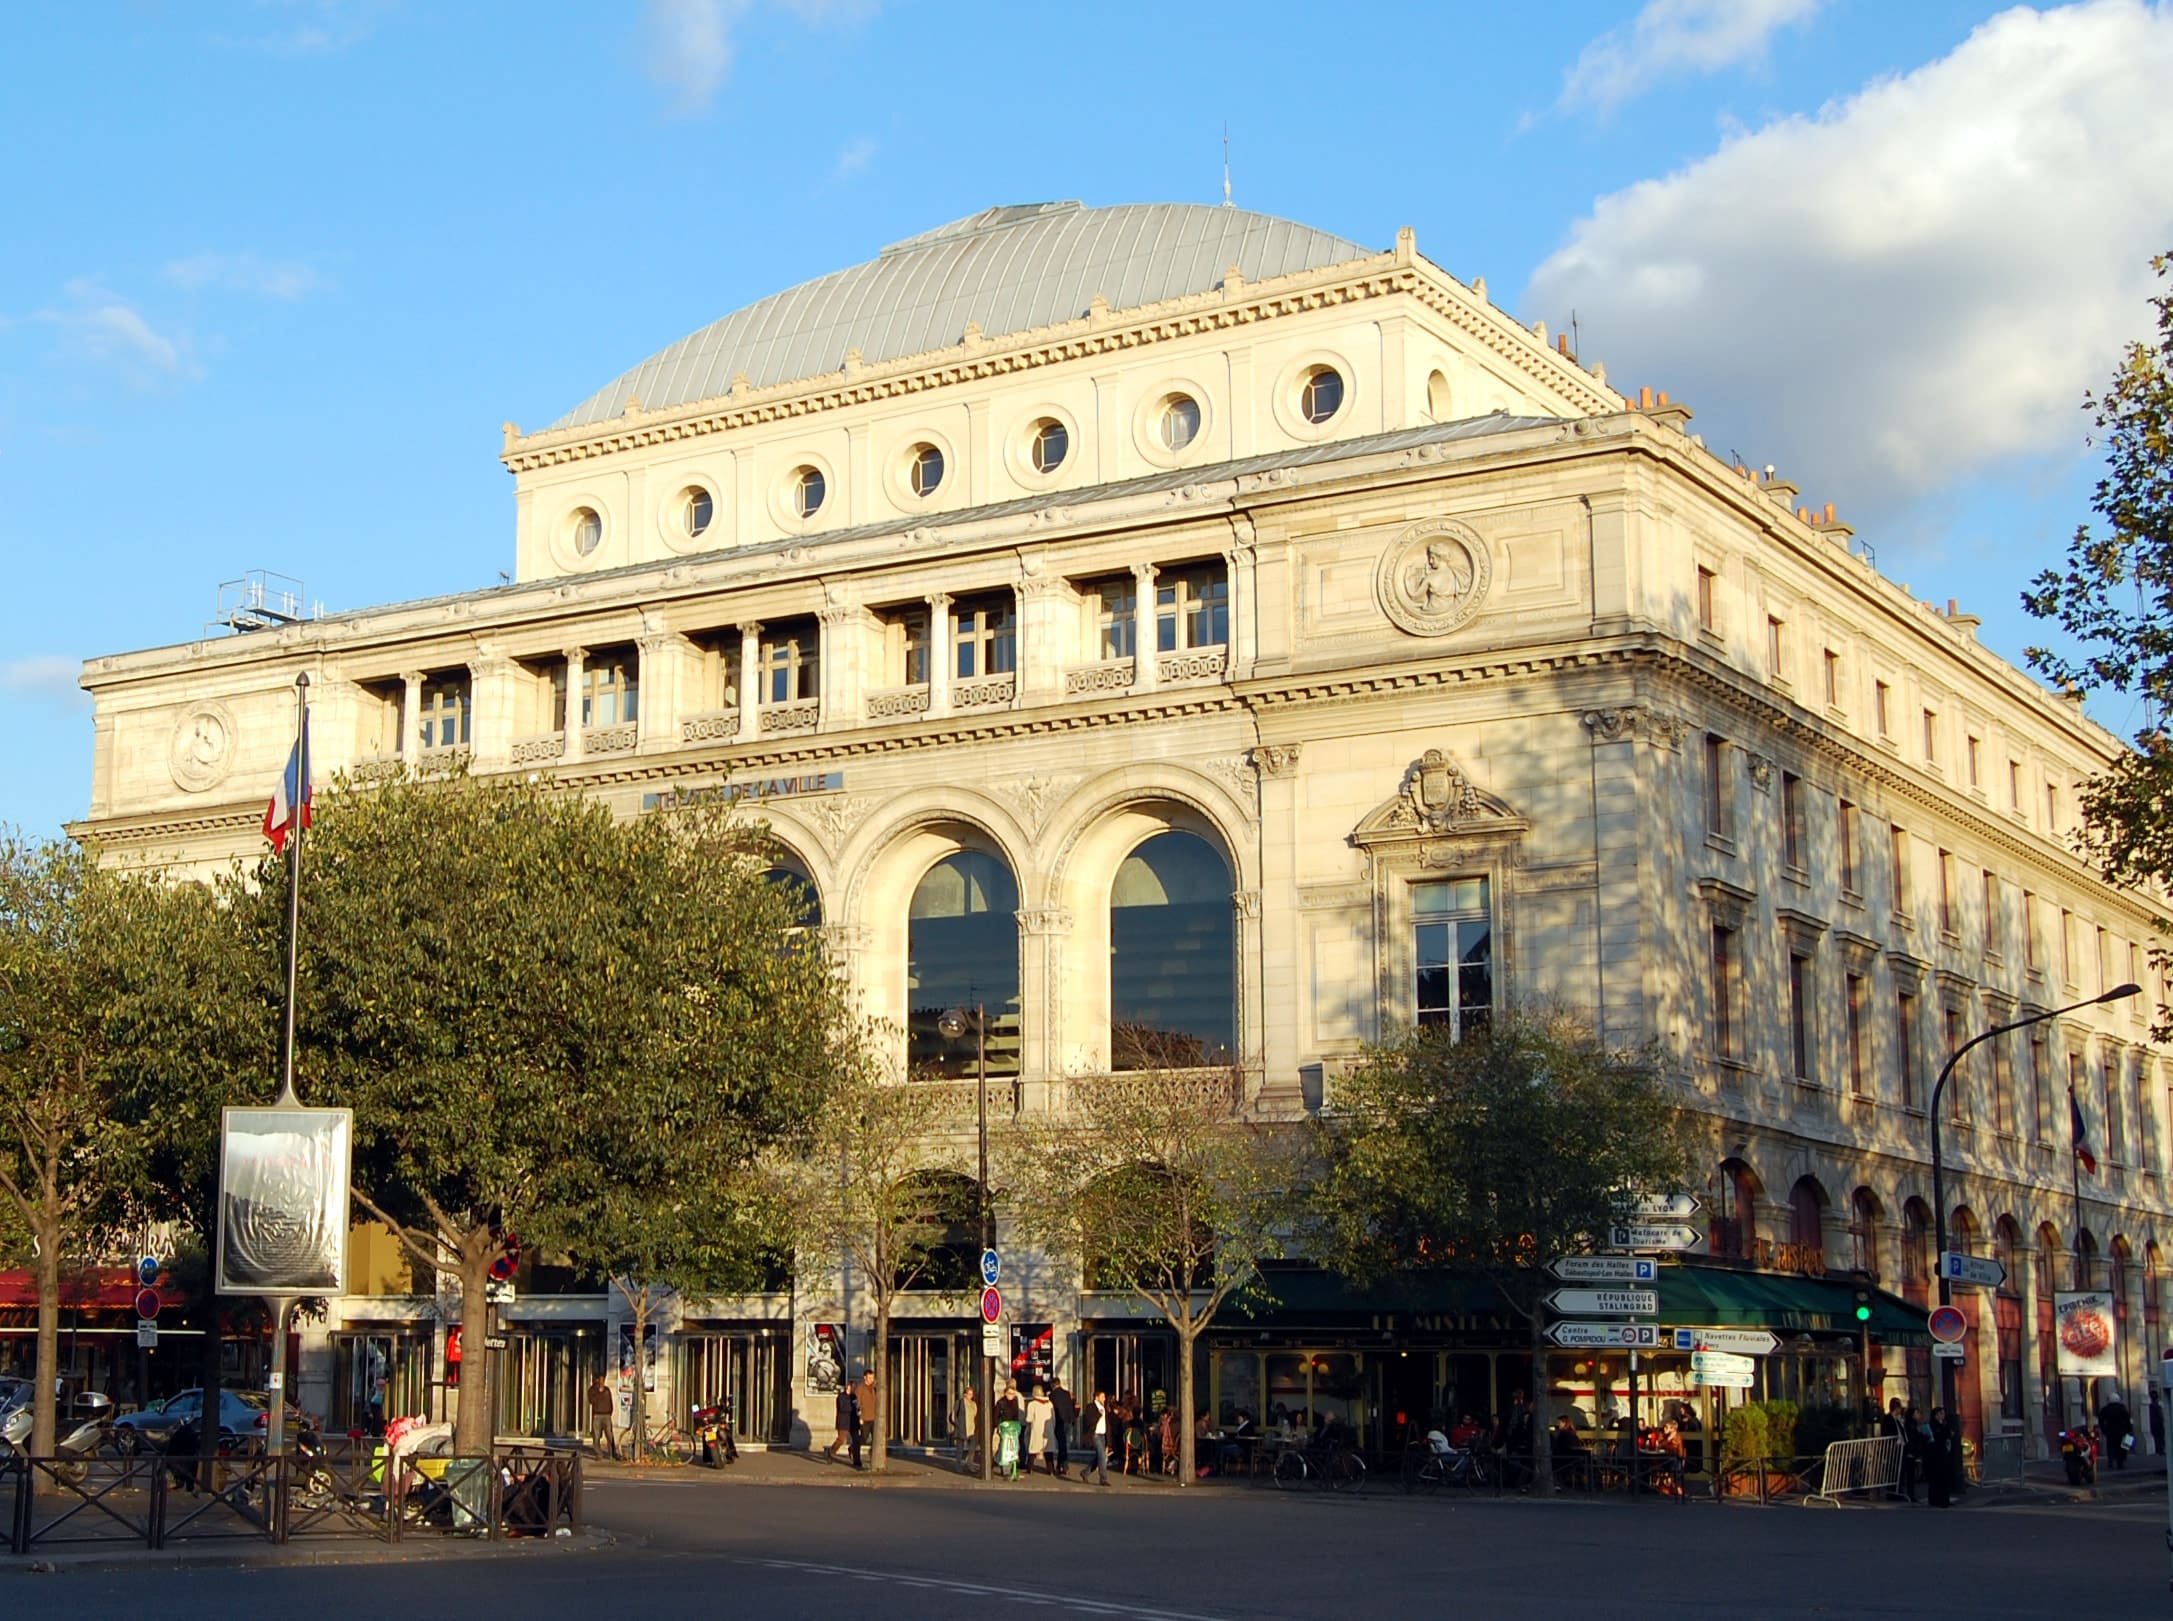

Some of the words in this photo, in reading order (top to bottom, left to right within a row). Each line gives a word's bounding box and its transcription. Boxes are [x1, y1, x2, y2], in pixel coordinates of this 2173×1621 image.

[730, 782, 753, 800] DE
[757, 780, 780, 797] LA
[782, 773, 828, 795] VILLE
[1565, 1260, 1589, 1268] Forum
[1591, 1260, 1604, 1268] des
[1606, 1261, 1629, 1269] Halles
[1640, 1264, 1648, 1277] P
[1597, 1291, 1653, 1301] RÉPUBLIQUE
[1599, 1303, 1653, 1311] STALINGRAD
[1562, 1326, 1588, 1334] Centre
[1642, 1331, 1650, 1340] P
[1704, 1332, 1736, 1340] Navettes
[1738, 1333, 1770, 1342] Fluviales
